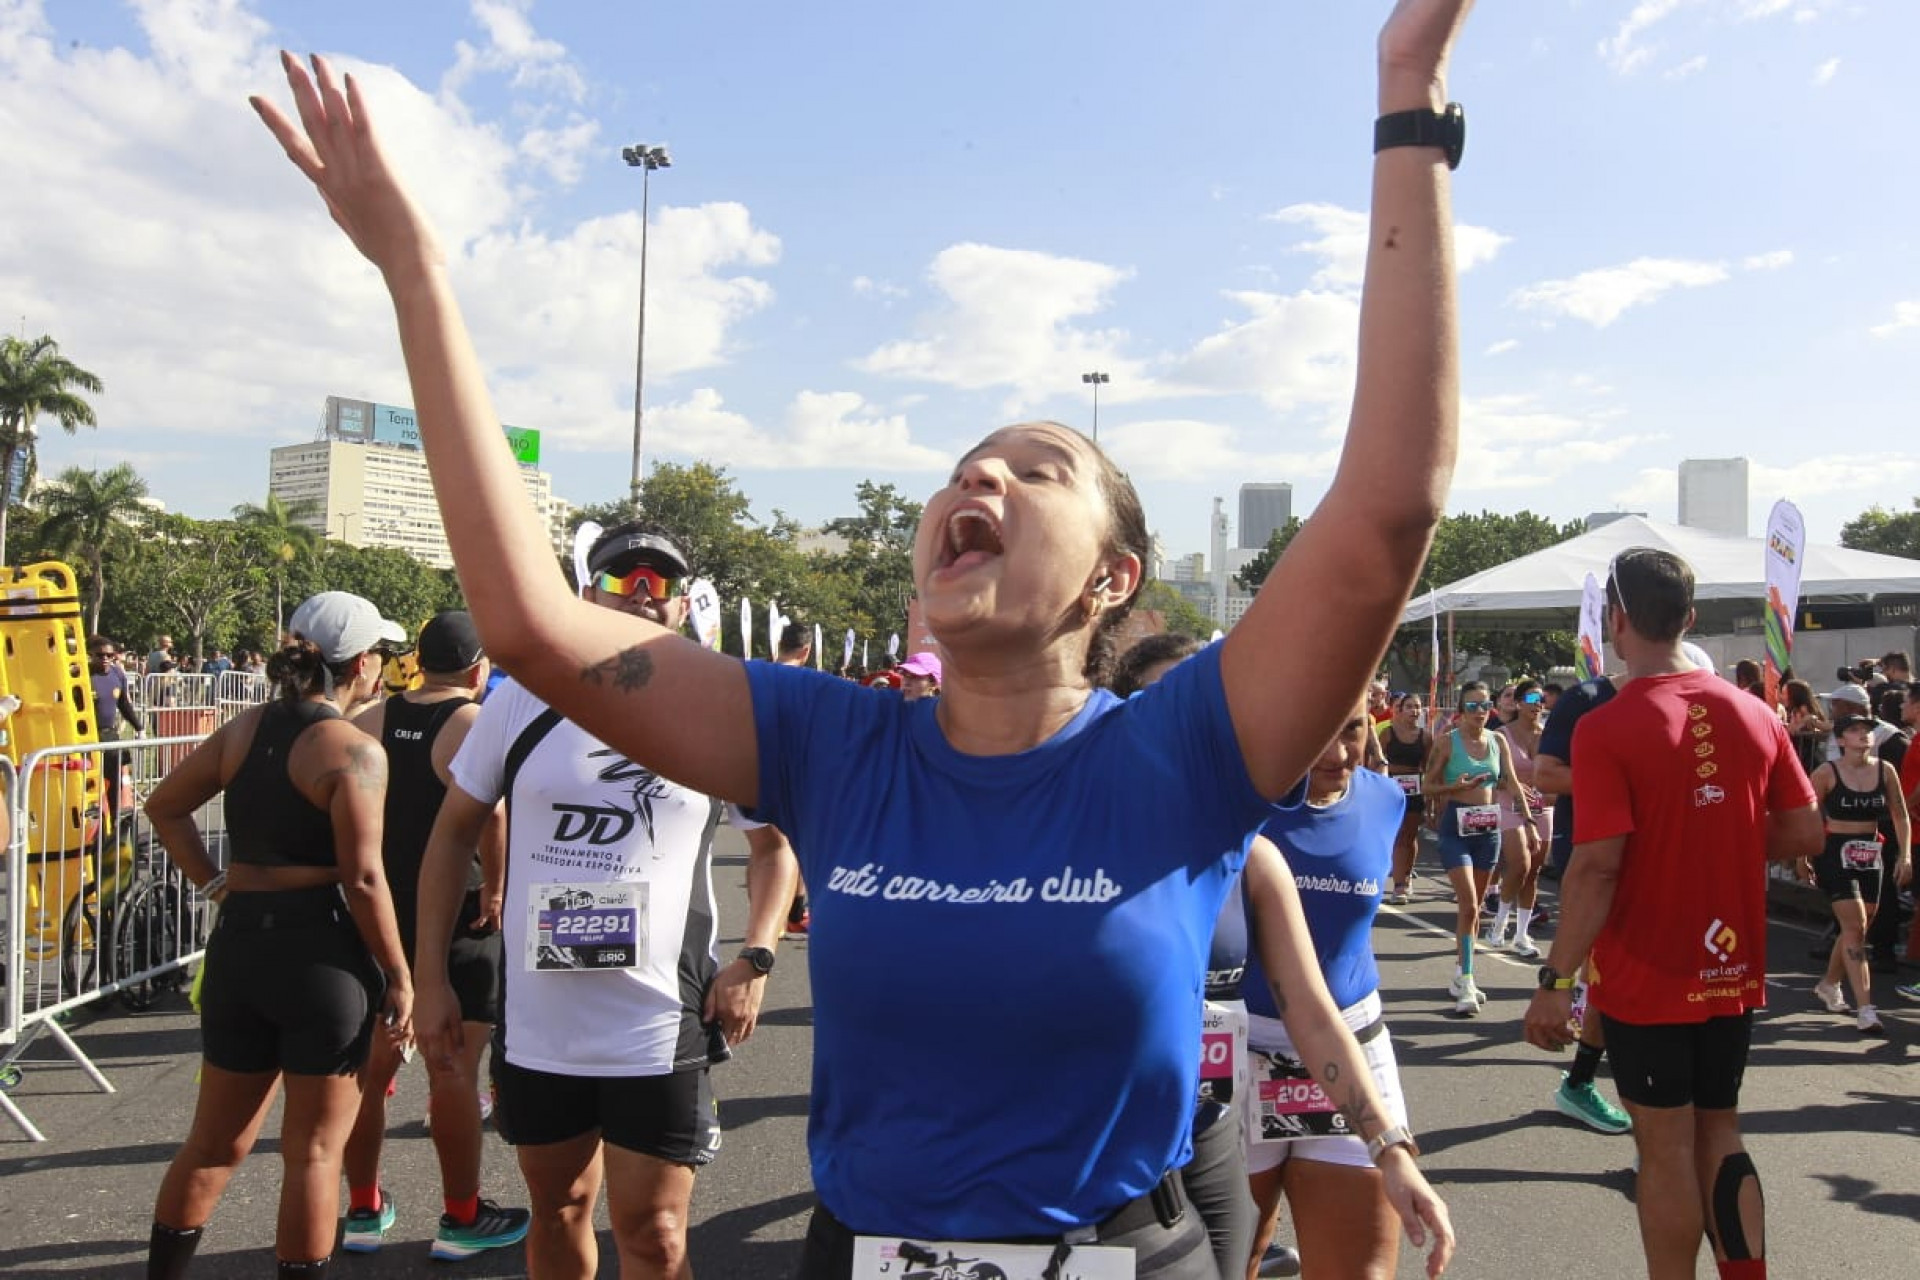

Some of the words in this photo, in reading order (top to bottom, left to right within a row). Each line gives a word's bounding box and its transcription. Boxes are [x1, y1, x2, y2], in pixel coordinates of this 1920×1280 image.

[1041, 866, 1121, 903] club
[1294, 873, 1352, 893] arreira
[1354, 877, 1380, 895] club
[556, 915, 630, 934] 22291
[1278, 1084, 1326, 1103] 203
[1331, 1114, 1345, 1128] G
